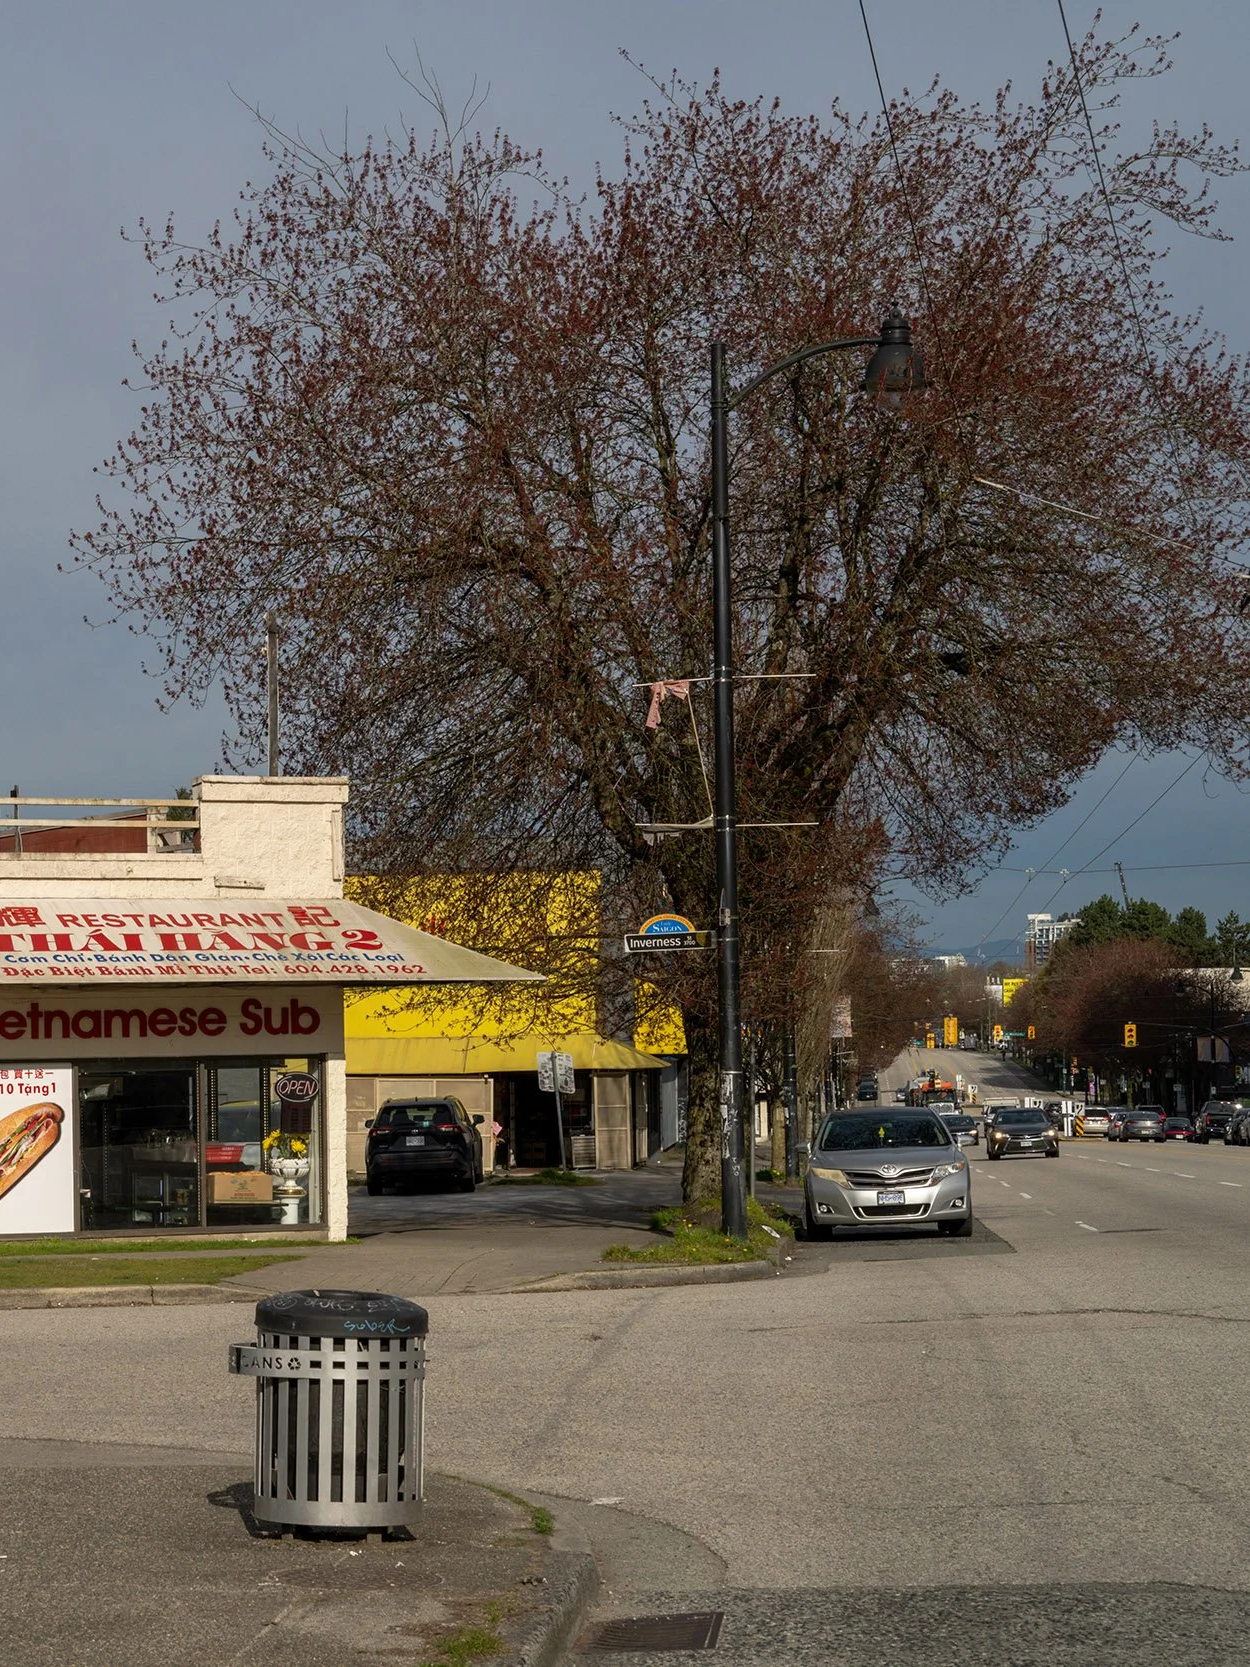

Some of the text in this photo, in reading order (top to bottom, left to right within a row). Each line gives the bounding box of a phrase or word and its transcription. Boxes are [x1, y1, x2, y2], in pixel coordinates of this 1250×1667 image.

[56, 913, 286, 928] RESTAURANT
[287, 905, 341, 928] 記
[341, 929, 383, 951] 2
[630, 938, 681, 948] Inverness
[238, 965, 278, 975] Tel:
[284, 964, 427, 975] 604.428.1962
[239, 999, 320, 1035] Sub
[0, 1083, 14, 1094] 10
[279, 1080, 314, 1095] OPEN
